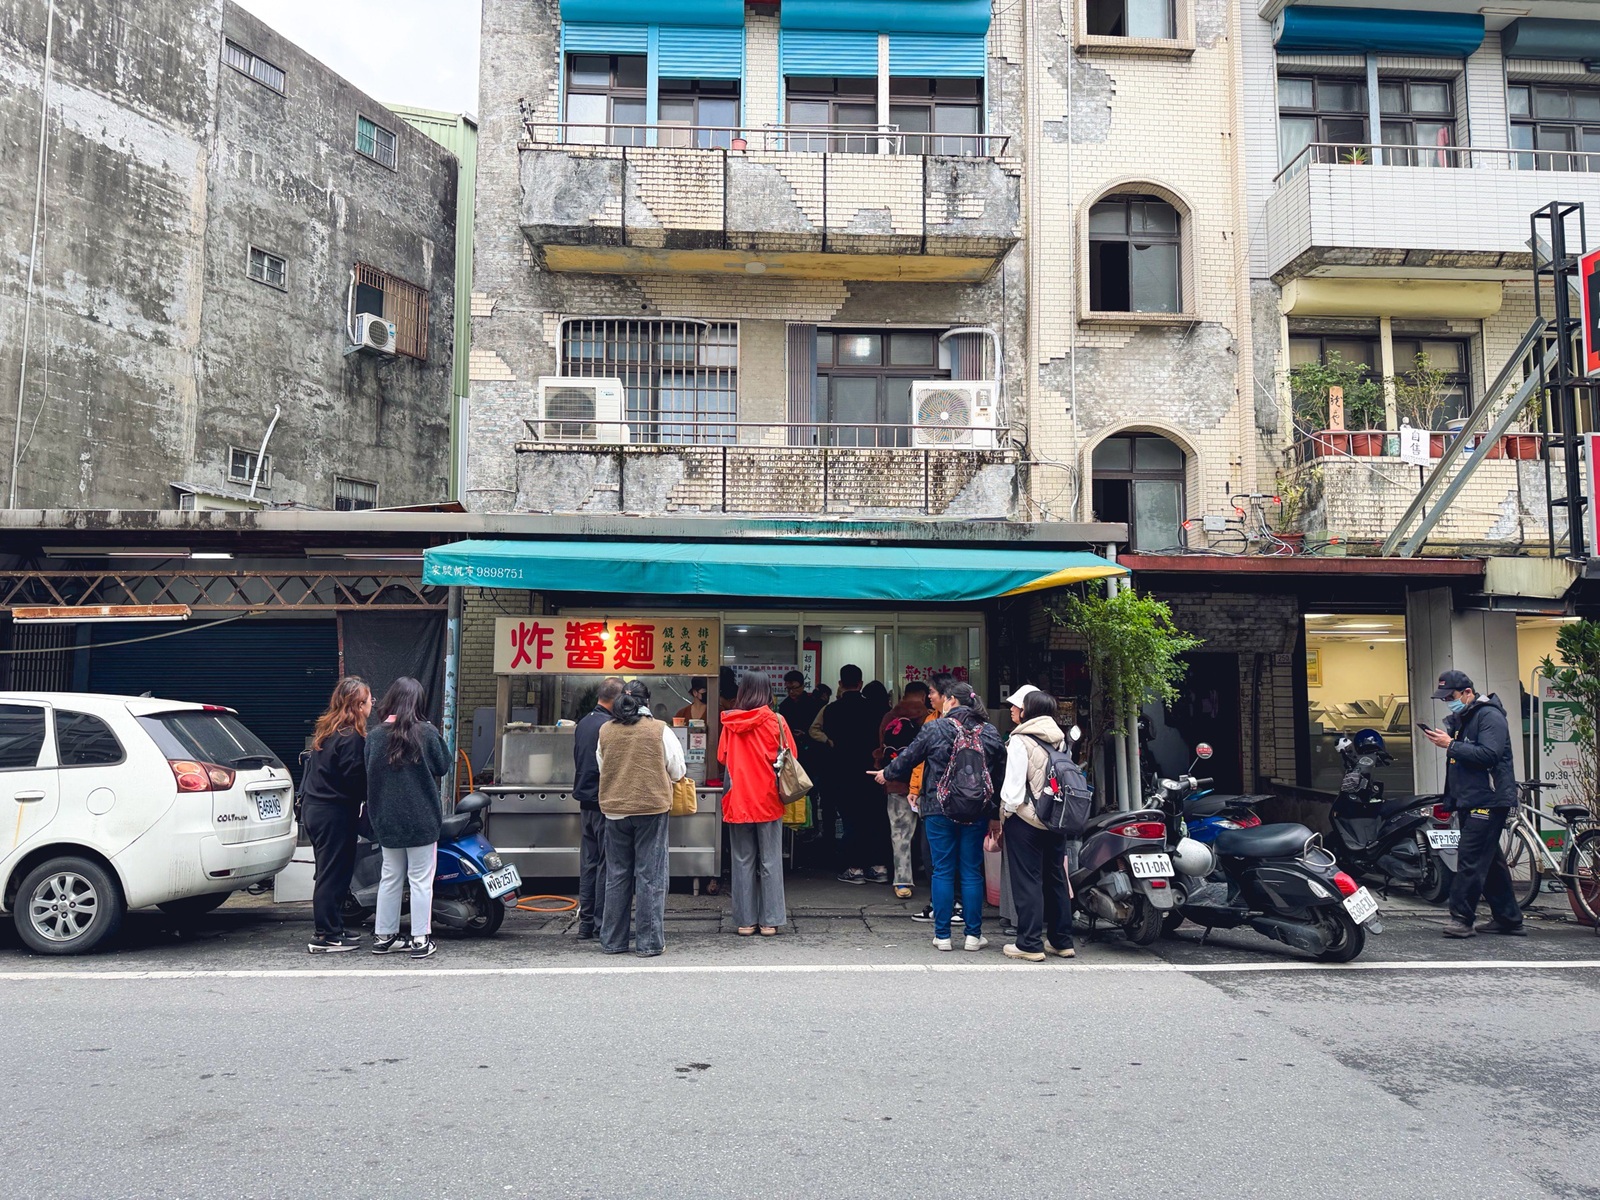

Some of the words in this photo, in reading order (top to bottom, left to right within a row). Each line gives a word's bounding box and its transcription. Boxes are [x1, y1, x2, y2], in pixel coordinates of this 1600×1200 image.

[476, 567, 524, 578] 9898751
[510, 621, 655, 670] 炸醬麵
[662, 627, 675, 667] 餛飩湯
[680, 627, 692, 667] 魚丸湯
[698, 627, 709, 667] 排骨湯
[1278, 654, 1290, 662] 250
[217, 814, 235, 823] COLT
[1133, 861, 1172, 874] 611-DAY
[486, 870, 518, 893] MVB-2571
